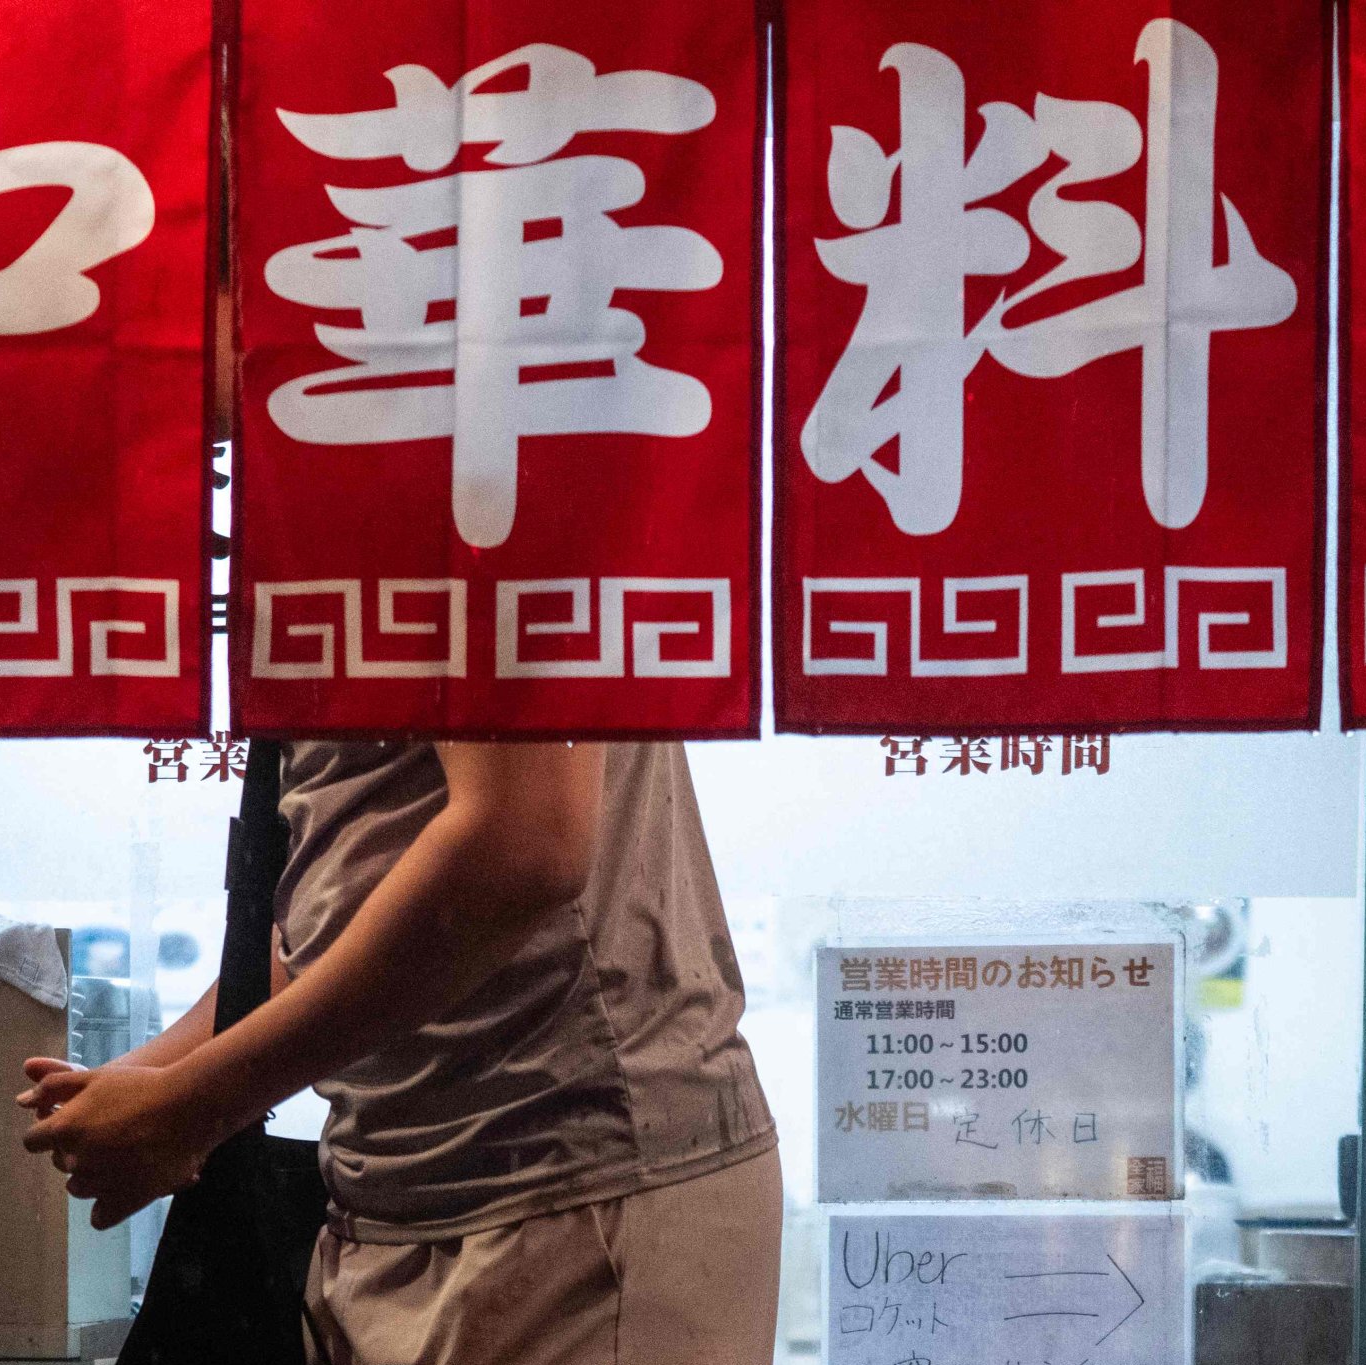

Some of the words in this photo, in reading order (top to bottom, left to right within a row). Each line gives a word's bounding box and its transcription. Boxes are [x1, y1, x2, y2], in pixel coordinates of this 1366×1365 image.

[880, 734, 1111, 776] 営業時間
[839, 955, 1155, 992] 営業時間のお知らせ
[834, 999, 956, 1021] 通常営業時間
[834, 1100, 931, 1133] 水曜日
[953, 1108, 1098, 1150] 定休日
[843, 1230, 968, 1289] Uber
[839, 1298, 949, 1335] ロケット
